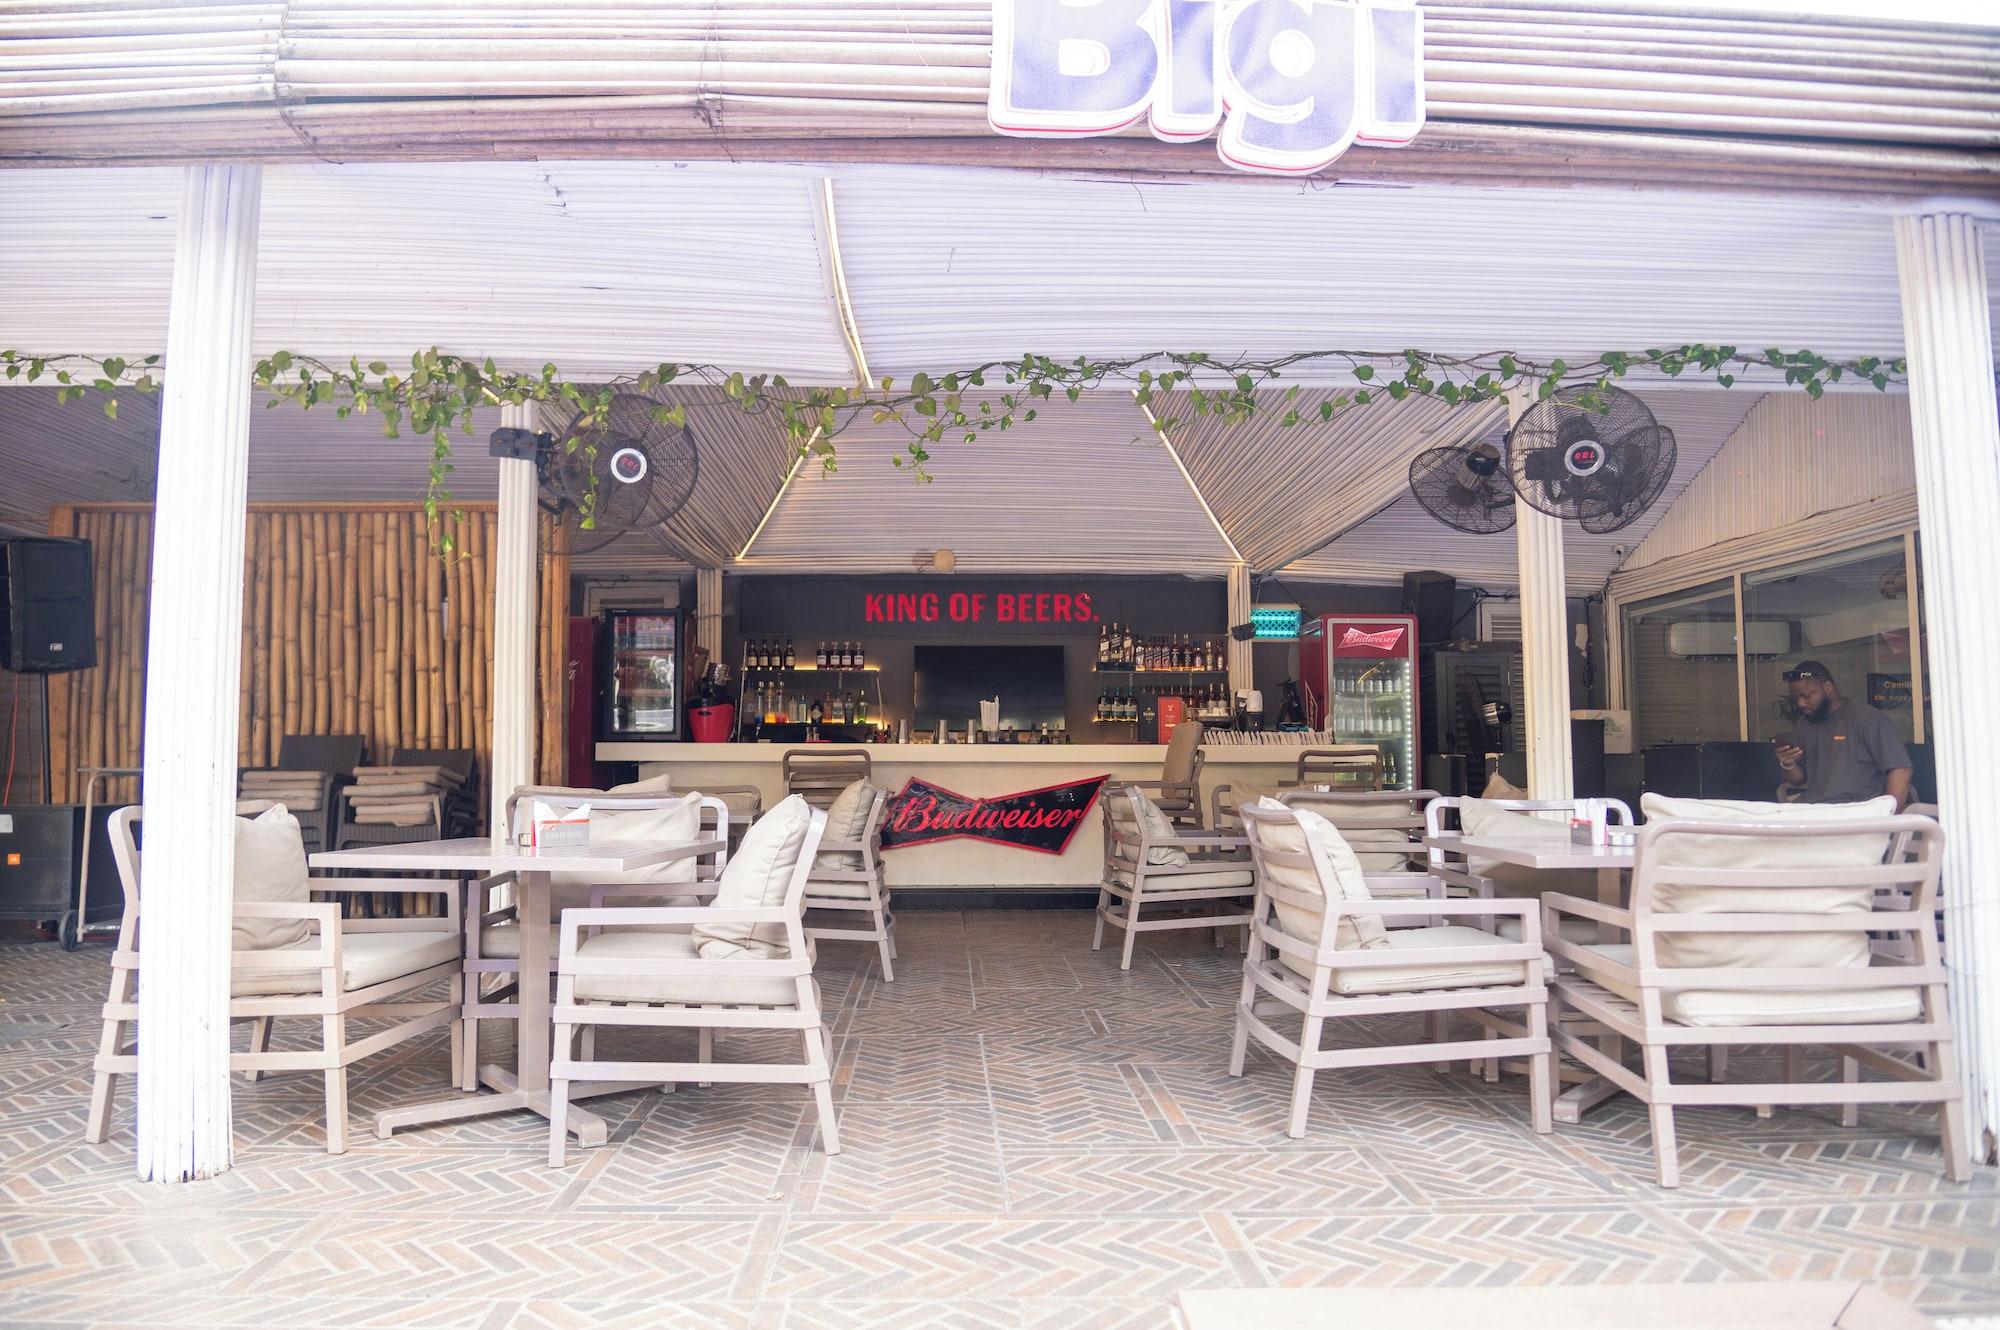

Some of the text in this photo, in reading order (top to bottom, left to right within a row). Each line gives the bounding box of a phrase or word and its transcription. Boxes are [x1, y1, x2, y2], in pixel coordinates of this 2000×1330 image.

[865, 592, 1100, 623] KING OF BEERS.
[1343, 632, 1399, 643] Budweiser
[892, 794, 1085, 833] Budweiser
